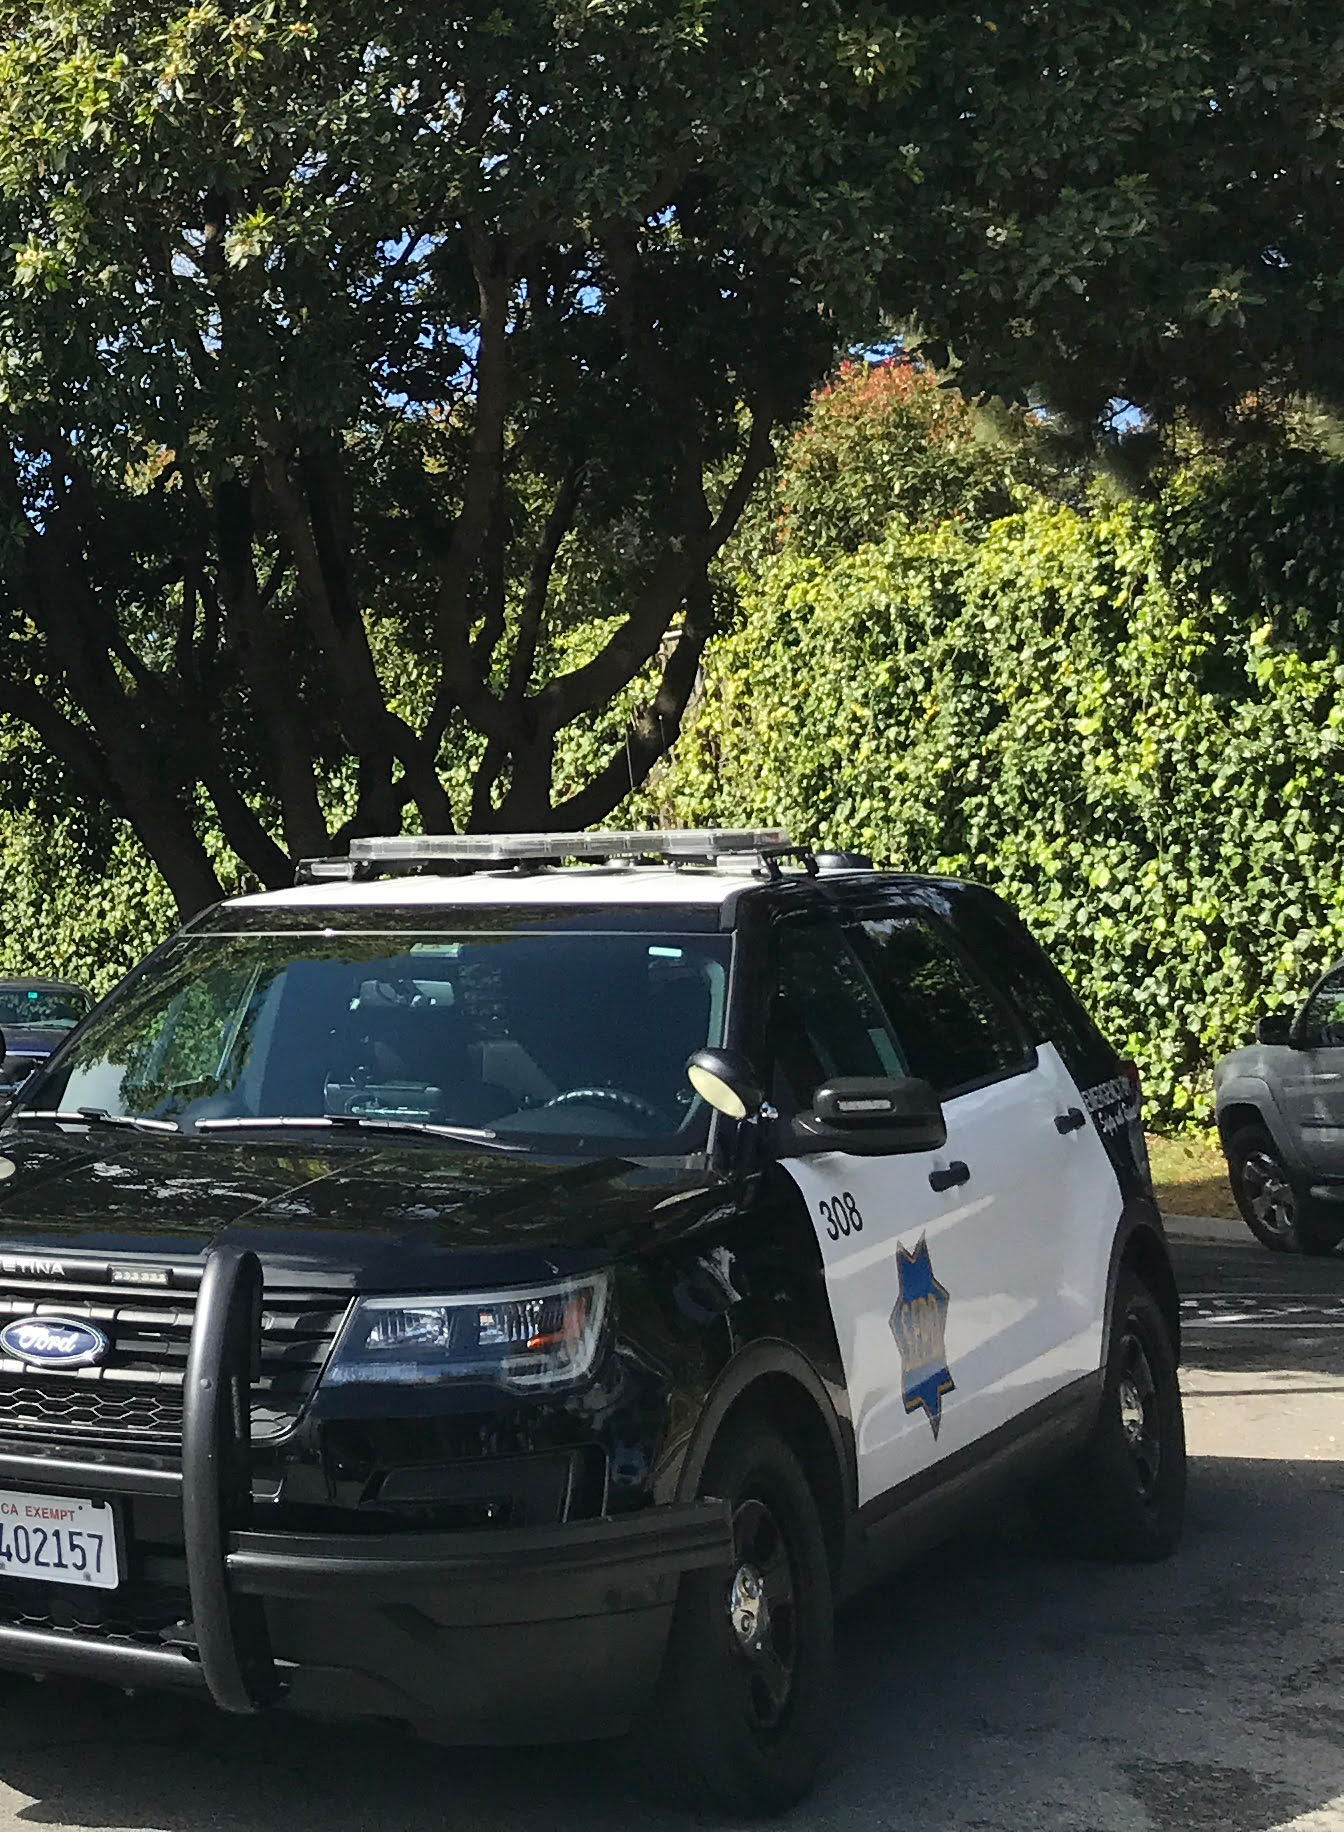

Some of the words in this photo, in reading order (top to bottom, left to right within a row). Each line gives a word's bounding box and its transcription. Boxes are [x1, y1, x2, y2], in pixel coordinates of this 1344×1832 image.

[819, 1191, 863, 1241] 308
[11, 1325, 80, 1352] Ford
[0, 1502, 19, 1516] CA
[25, 1505, 76, 1522] EXEMPT
